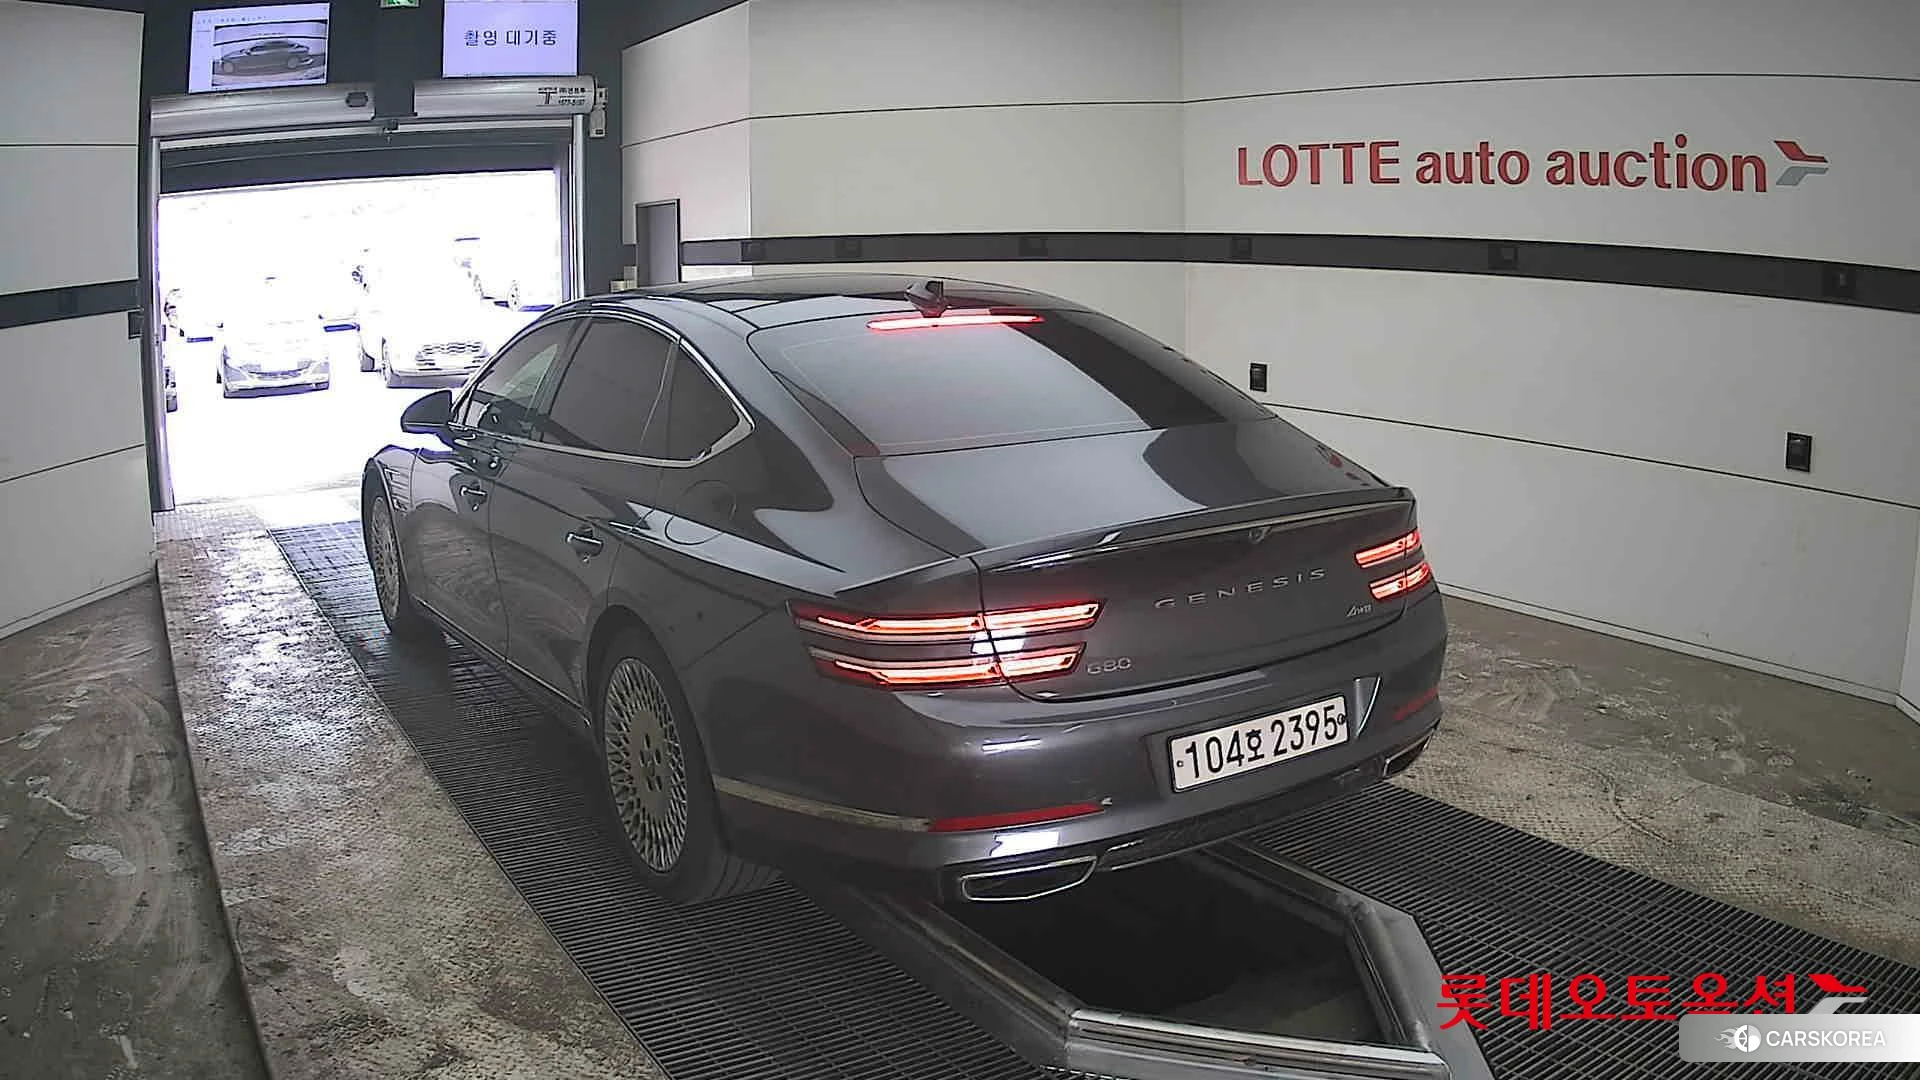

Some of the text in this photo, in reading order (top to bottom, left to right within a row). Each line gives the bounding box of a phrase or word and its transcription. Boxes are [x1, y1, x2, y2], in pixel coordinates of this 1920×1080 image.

[465, 30, 557, 47] 촬영 대기중
[1237, 134, 1767, 192] LOTTE auto auction
[1154, 568, 1325, 608] GENESIS
[1087, 657, 1131, 674] G80
[1185, 704, 1338, 779] 104호 2395
